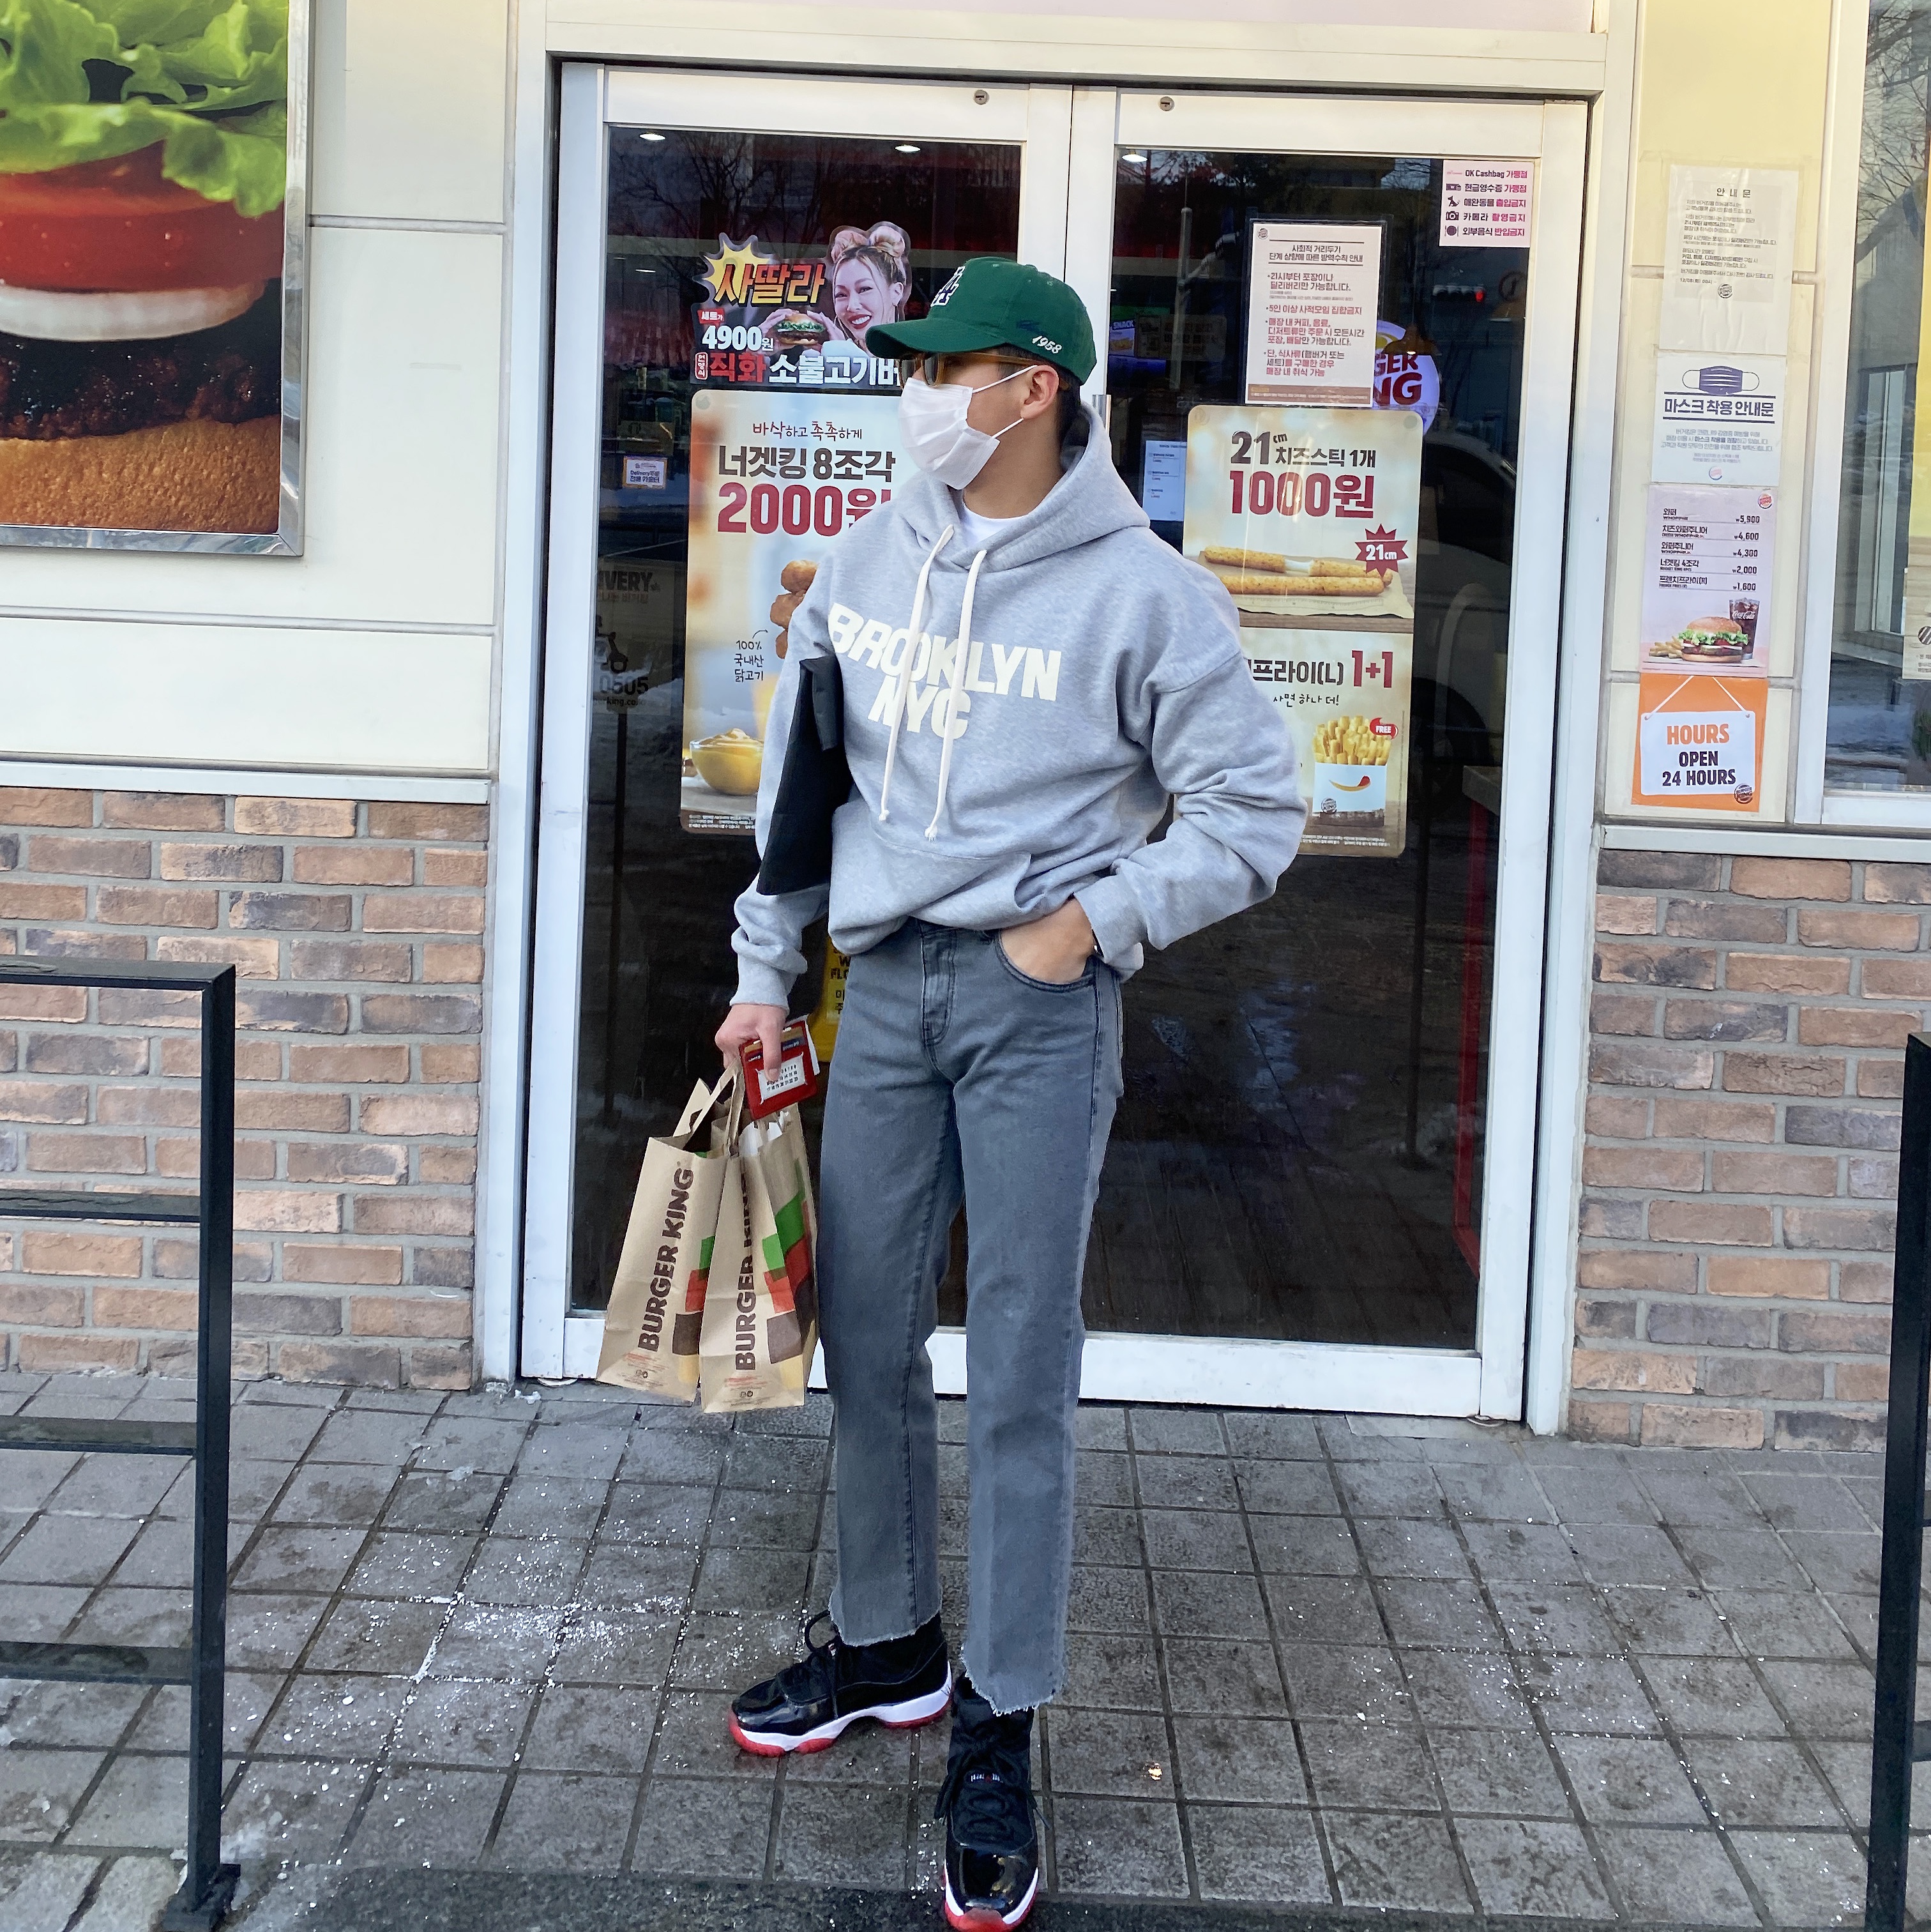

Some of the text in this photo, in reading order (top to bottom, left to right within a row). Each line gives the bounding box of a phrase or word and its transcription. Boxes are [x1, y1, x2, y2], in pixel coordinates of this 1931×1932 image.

[1476, 170, 1504, 178] Cashbag
[1465, 184, 1527, 193] 현금영수증 가맹점
[1464, 199, 1526, 208] 애완동물 출입금지
[1463, 213, 1526, 222] 카메라 촬영금지
[1462, 227, 1525, 236] 외부음식 반입금지
[1292, 245, 1341, 254] 사회적 거리두기
[1271, 273, 1333, 282] 21시부터 포장이나
[713, 263, 826, 307] 사딸라
[1271, 282, 1351, 291] 딜리버리만 가능합니다.
[701, 310, 723, 321] 세트가
[1283, 305, 1297, 314] 이상
[1299, 305, 1329, 314] 사적모임
[1332, 307, 1362, 315] 집합금지
[1285, 318, 1292, 326] 내
[702, 326, 773, 351] 4900원
[1268, 327, 1306, 335] 디저트류만
[1334, 329, 1364, 337] 모든시간
[1032, 335, 1063, 354] 1958
[1311, 337, 1351, 346] 가능합니다.
[709, 353, 766, 382] 직화
[1310, 369, 1324, 377] 가능
[1665, 399, 1774, 416] 마스크 착용 안내문
[753, 421, 862, 441] 바삭하고 촉촉하게
[719, 445, 895, 482] 너겟킹 8조각
[1276, 447, 1345, 467] 치즈스틱
[1349, 450, 1375, 468] 1개
[1230, 471, 1374, 519] 1000원
[1663, 525, 1708, 534] 치즈와퍼주니어
[1366, 544, 1397, 561] 21cm
[1662, 542, 1693, 551] 와퍼주니어
[736, 641, 762, 650] 100%
[828, 602, 1061, 701] BROOKLYN
[734, 653, 764, 667] 국내산
[735, 669, 763, 683] 닭고기
[1248, 650, 1393, 688] 프라이(L) 1+1
[867, 676, 971, 739] NYC
[1273, 694, 1339, 707] 사면 하나 더!
[1375, 726, 1391, 734] FREE
[1667, 724, 1729, 745] HOURS
[1679, 751, 1718, 767] OPEN
[1663, 769, 1736, 786] 24 HOURS
[638, 1244, 678, 1351] BURGER
[662, 1168, 694, 1239] KING
[735, 1254, 756, 1371] BURGER
